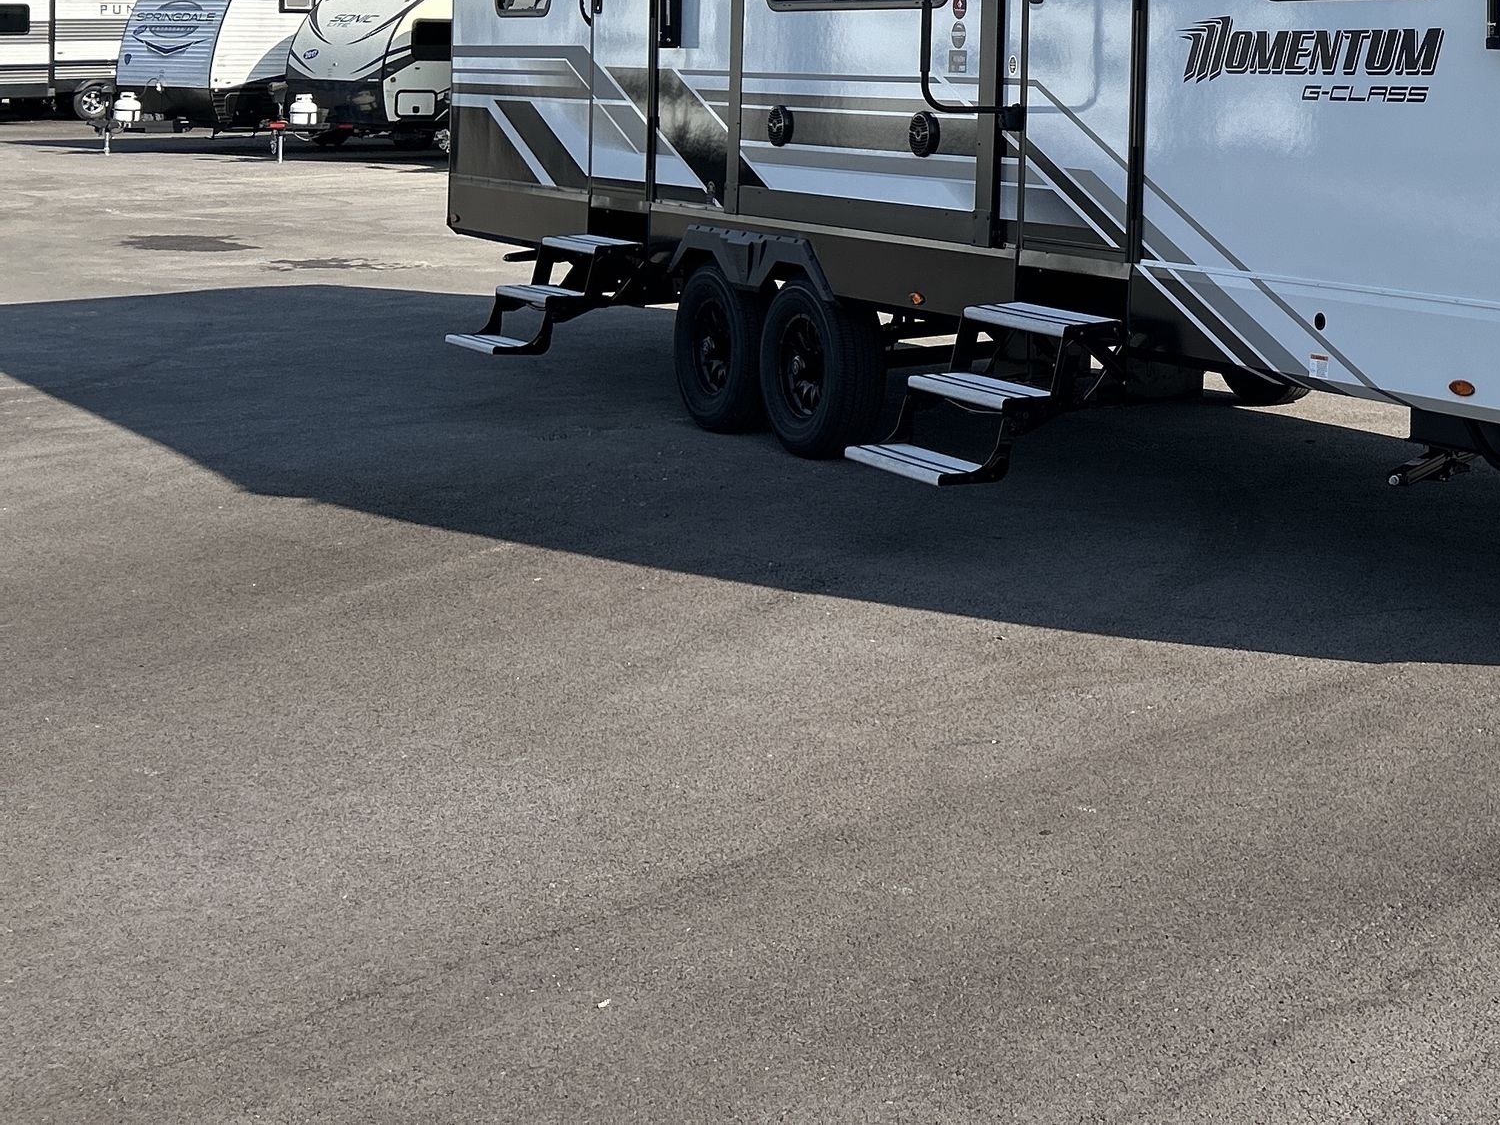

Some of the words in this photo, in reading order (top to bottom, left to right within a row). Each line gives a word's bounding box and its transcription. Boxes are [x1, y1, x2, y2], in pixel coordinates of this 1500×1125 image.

[136, 12, 217, 22] SPRINGDALE
[330, 14, 380, 24] SONIC
[1176, 15, 1445, 84] MOMENTUM
[1301, 84, 1430, 103] G-CLASS
